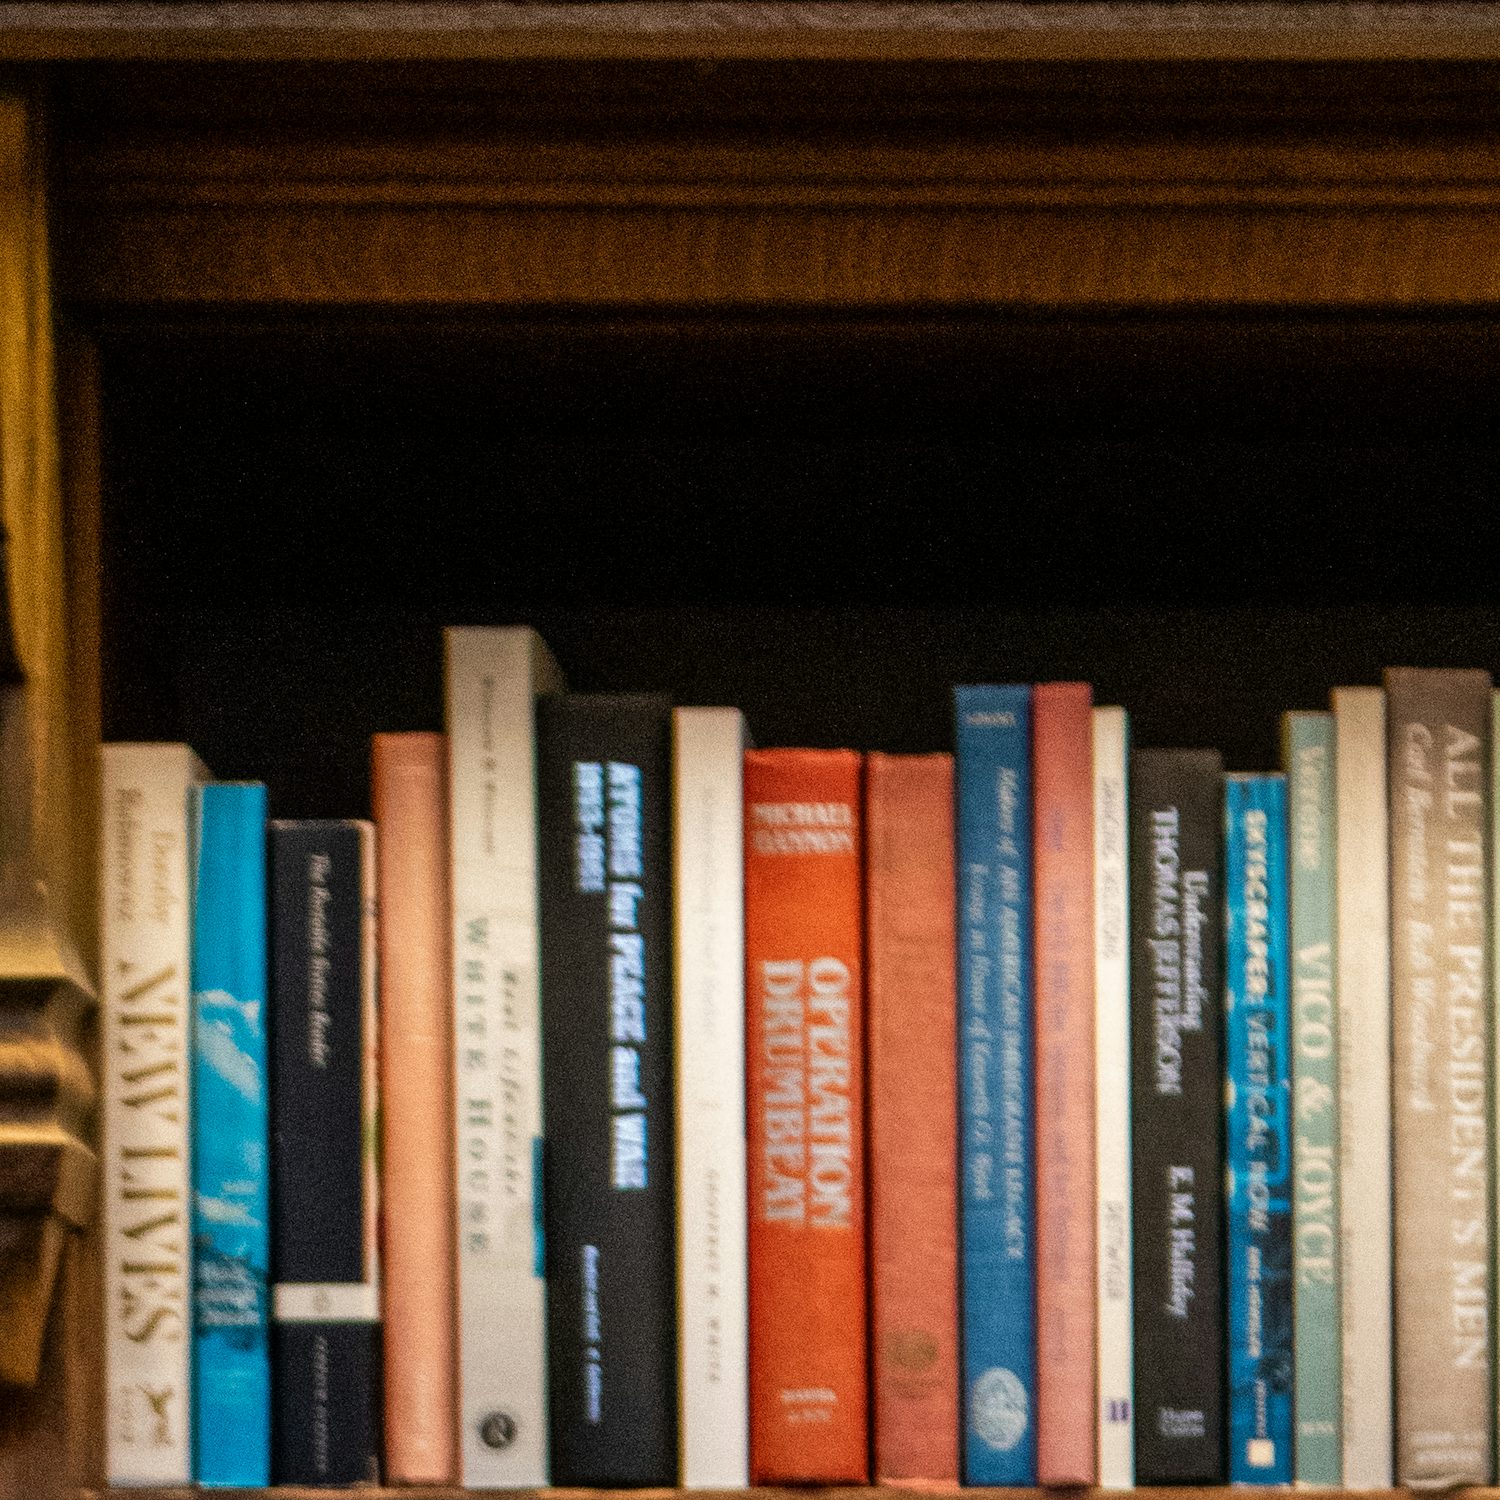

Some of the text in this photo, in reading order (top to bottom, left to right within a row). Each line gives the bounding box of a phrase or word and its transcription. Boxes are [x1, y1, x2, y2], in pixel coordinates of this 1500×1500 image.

[1447, 724, 1485, 818] ALL
[1447, 840, 1485, 929] THE
[1148, 808, 1184, 1097] THOMAS JEFFERSON
[119, 960, 178, 1345] NEW LIVES
[764, 961, 805, 1223] DRUMBEAT
[810, 958, 852, 1230] OPERATION
[1297, 942, 1334, 1287] VICO & JOYCE
[1450, 1261, 1488, 1370] MEN
